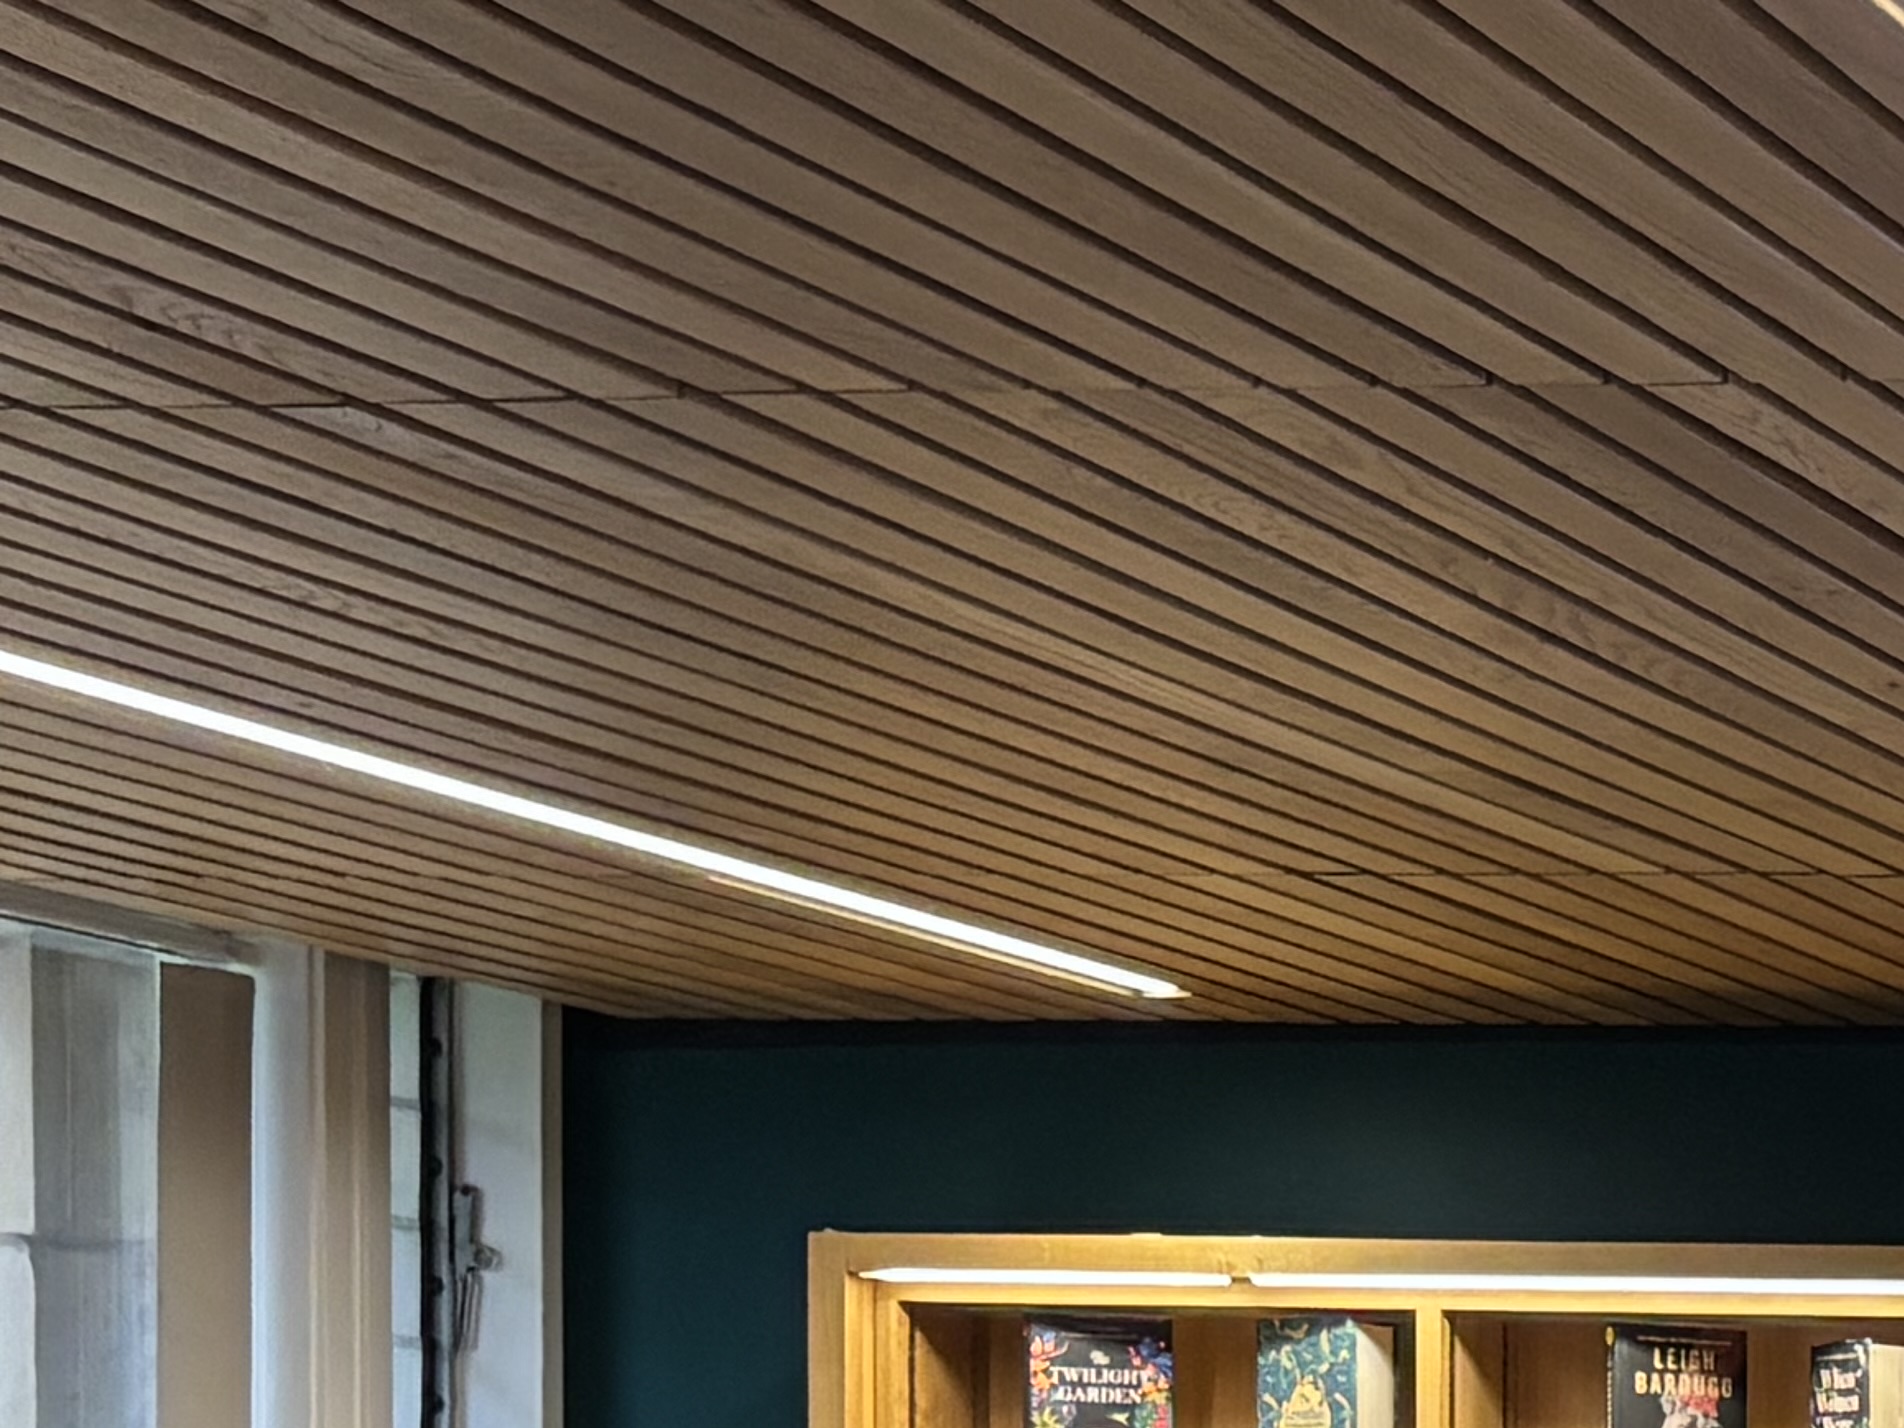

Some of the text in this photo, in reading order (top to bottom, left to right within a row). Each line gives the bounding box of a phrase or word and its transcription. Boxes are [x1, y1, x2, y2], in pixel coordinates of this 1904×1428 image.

[1653, 1348, 1716, 1371] LEIGH
[1056, 1384, 1145, 1404] GARDEN
[1633, 1371, 1734, 1399] BARDUGO
